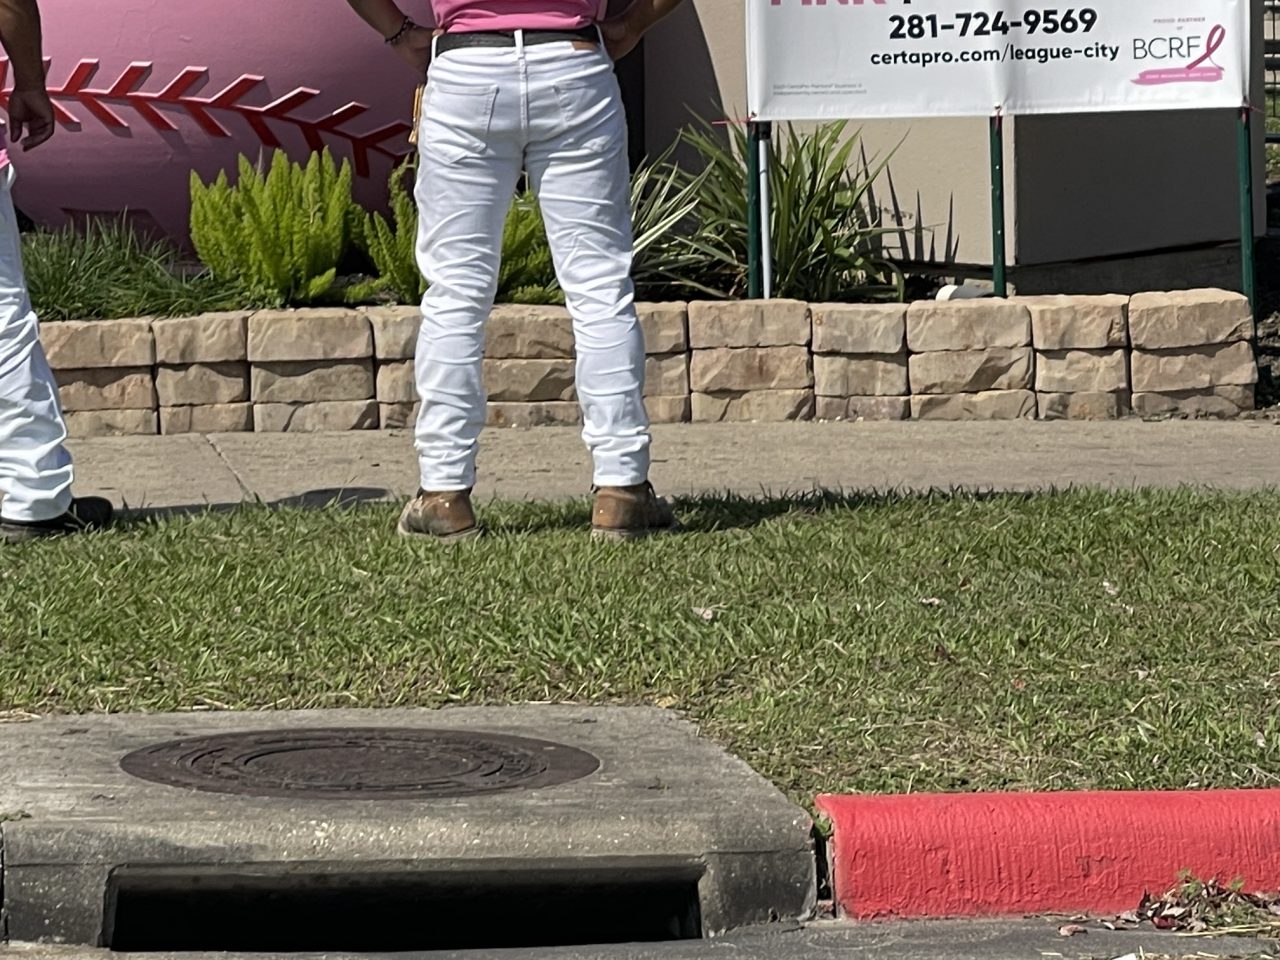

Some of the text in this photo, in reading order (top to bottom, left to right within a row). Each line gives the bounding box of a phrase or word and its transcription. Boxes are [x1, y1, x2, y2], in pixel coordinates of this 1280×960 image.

[889, 8, 1098, 39] 281-724-9569
[870, 42, 1120, 67] certapro.com/league-city
[1133, 36, 1201, 59] BCRF
